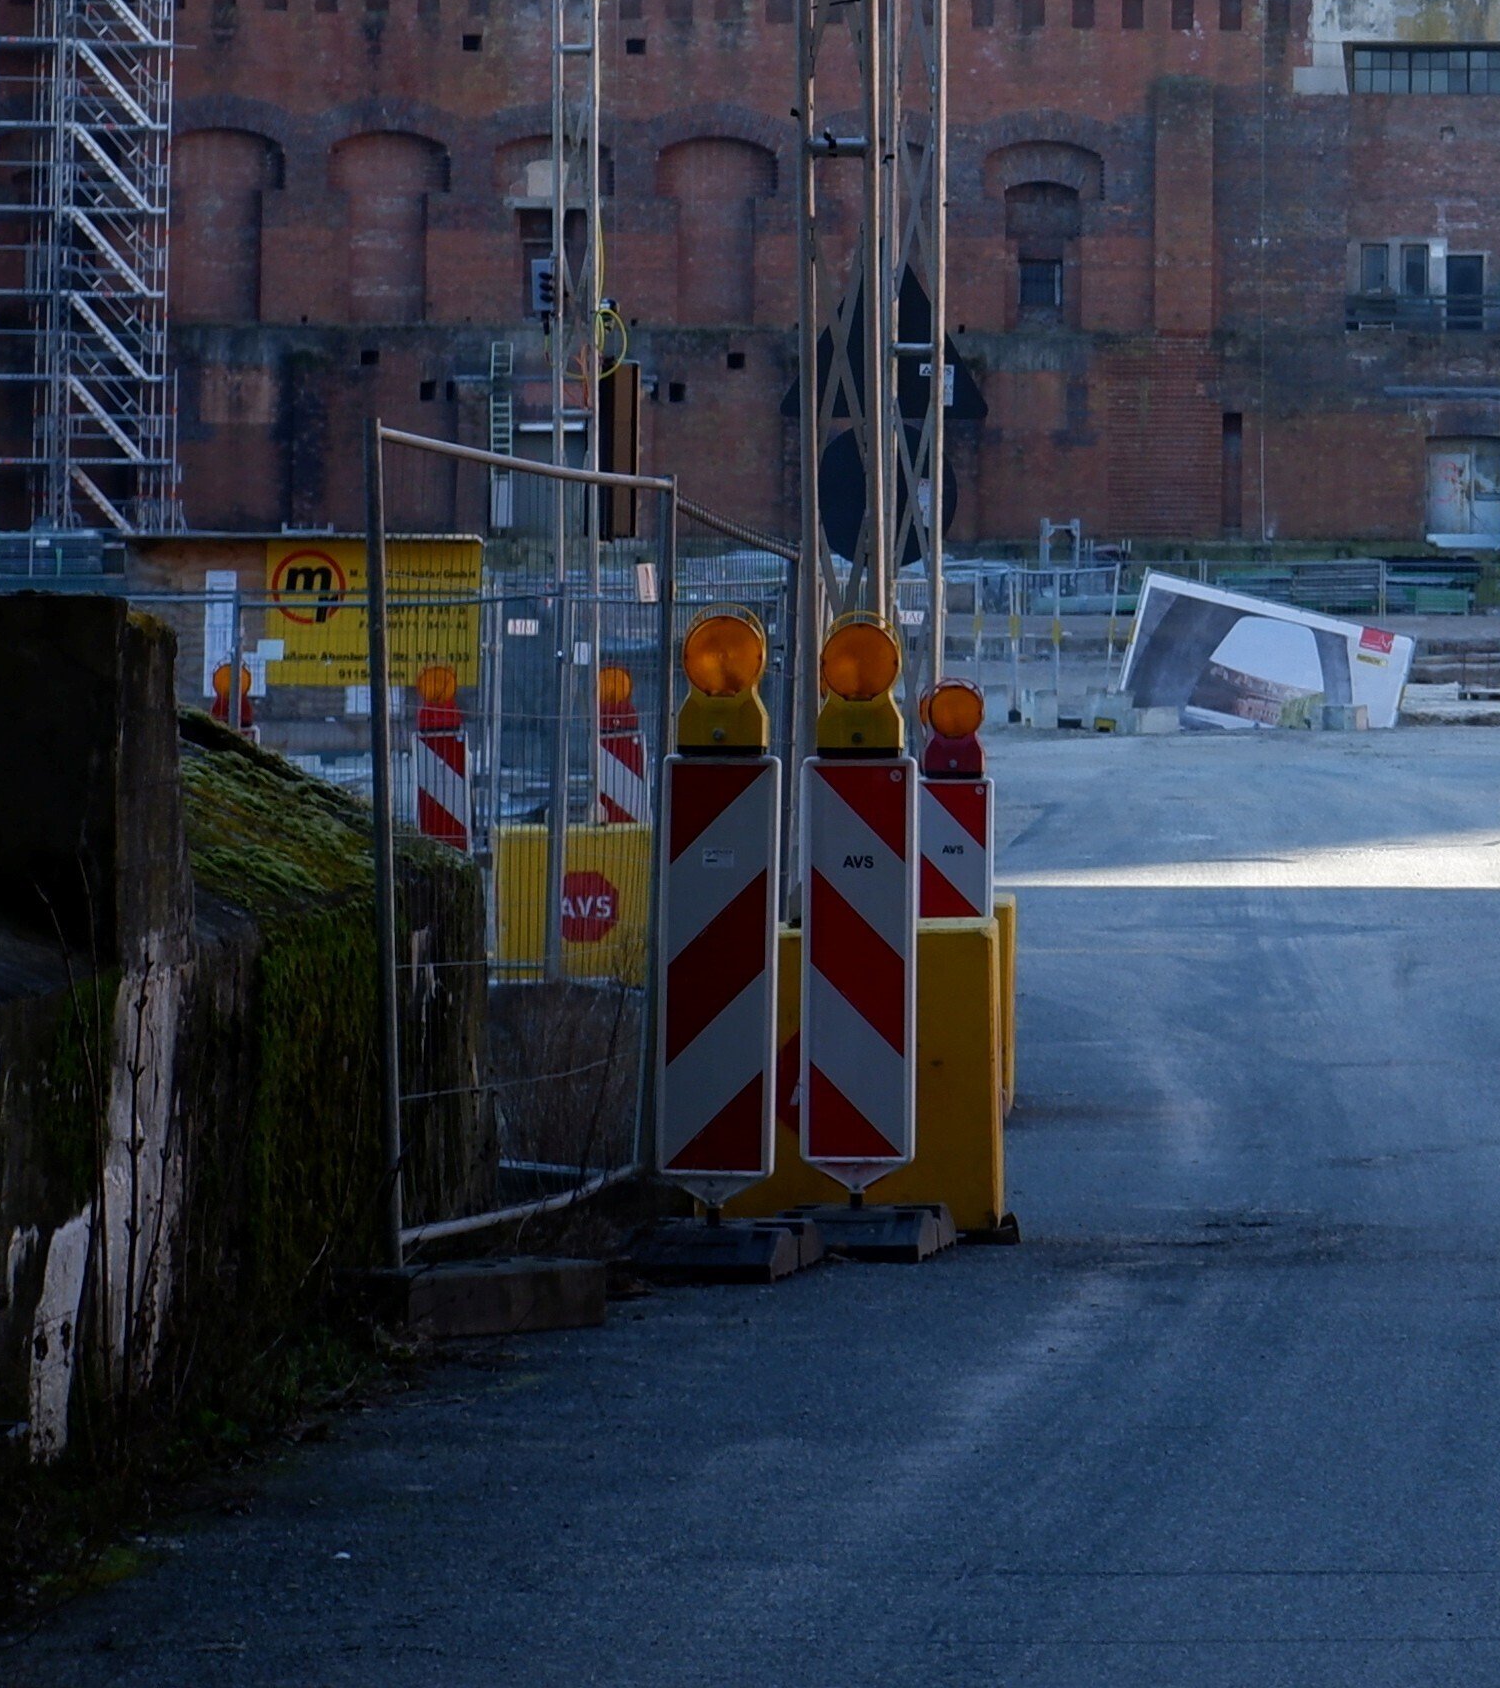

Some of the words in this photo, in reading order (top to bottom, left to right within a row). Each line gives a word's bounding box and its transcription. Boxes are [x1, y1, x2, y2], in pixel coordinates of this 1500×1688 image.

[283, 652, 317, 661] ußere
[338, 668, 369, 679] 9115
[942, 845, 964, 855] AVS
[843, 855, 874, 869] AVS
[561, 895, 611, 919] AVS
